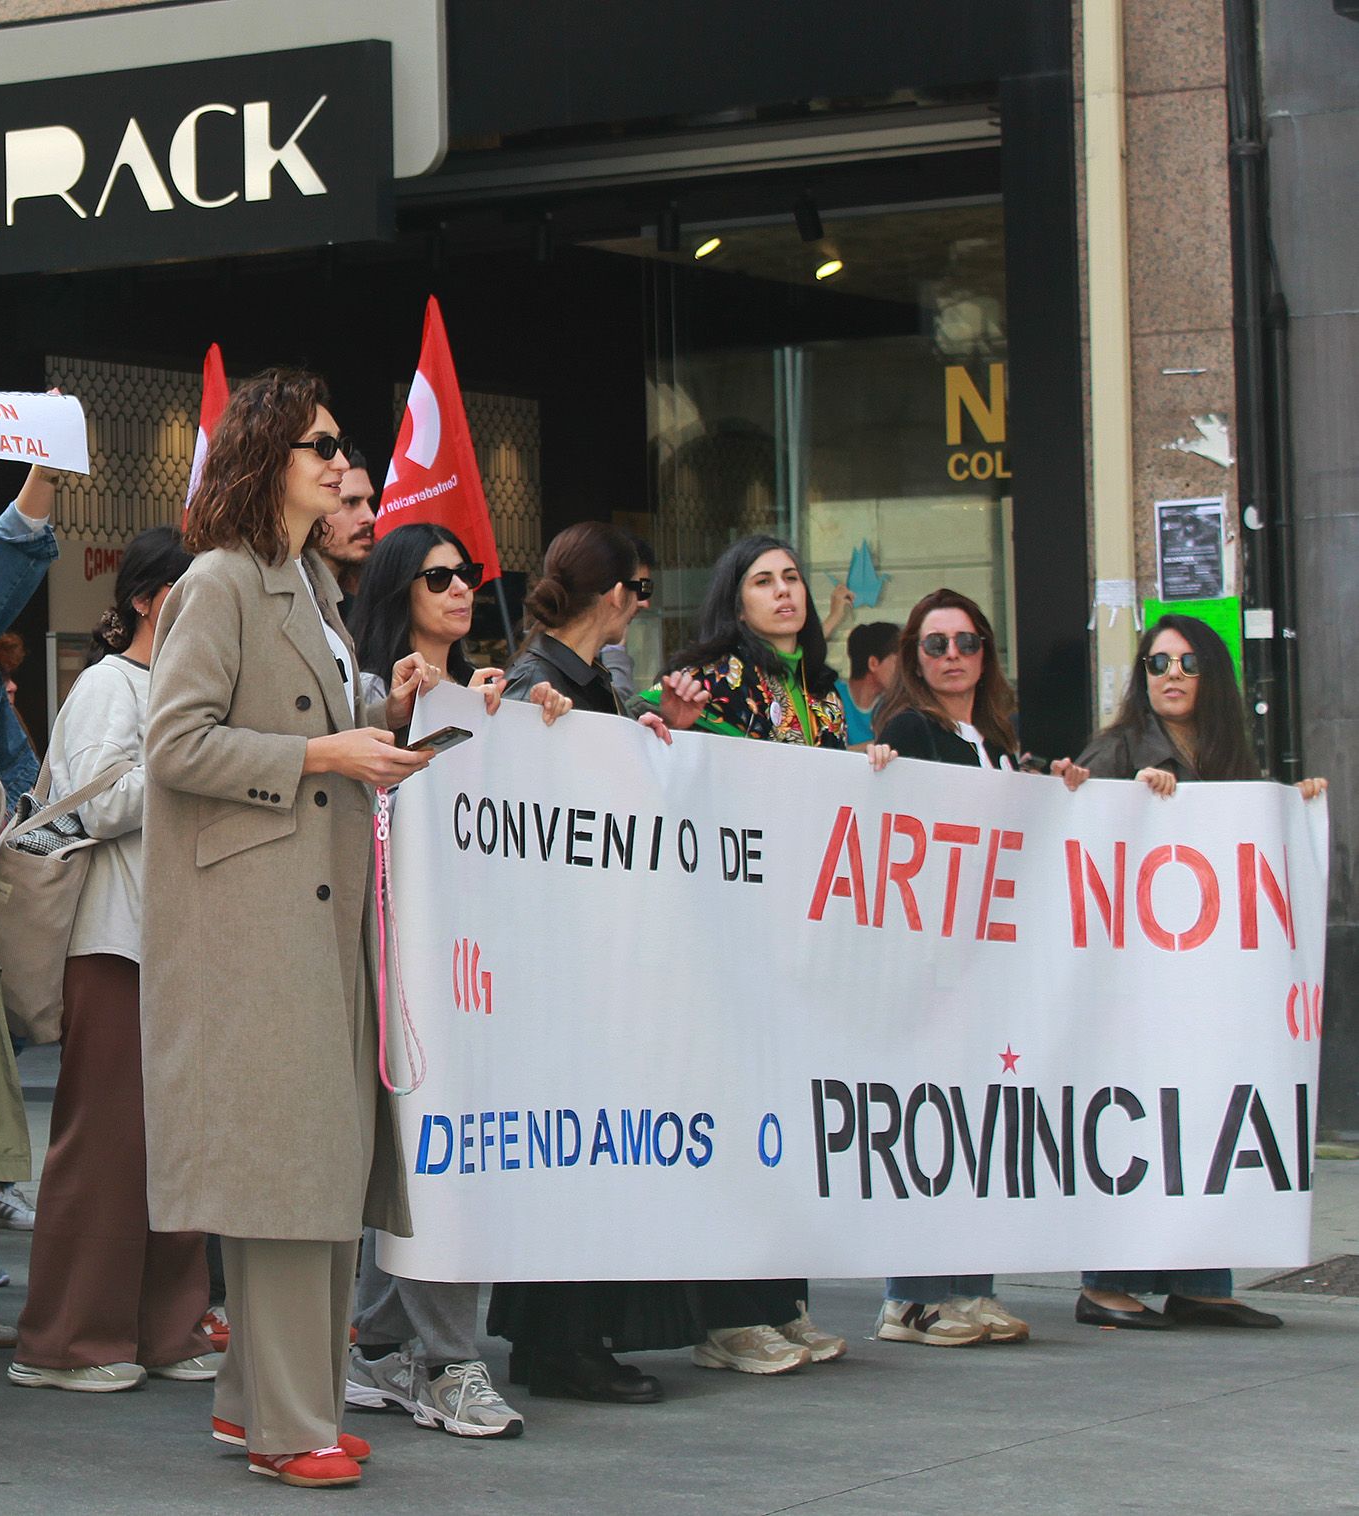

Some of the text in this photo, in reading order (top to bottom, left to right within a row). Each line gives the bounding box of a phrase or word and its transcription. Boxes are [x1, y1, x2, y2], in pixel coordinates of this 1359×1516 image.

[945, 363, 1006, 446] N
[947, 451, 1012, 481] COL
[452, 791, 1297, 953] CONVENIO DE ARTE NON
[413, 1107, 715, 1176] DEFENDAMOS
[757, 1111, 783, 1169] O
